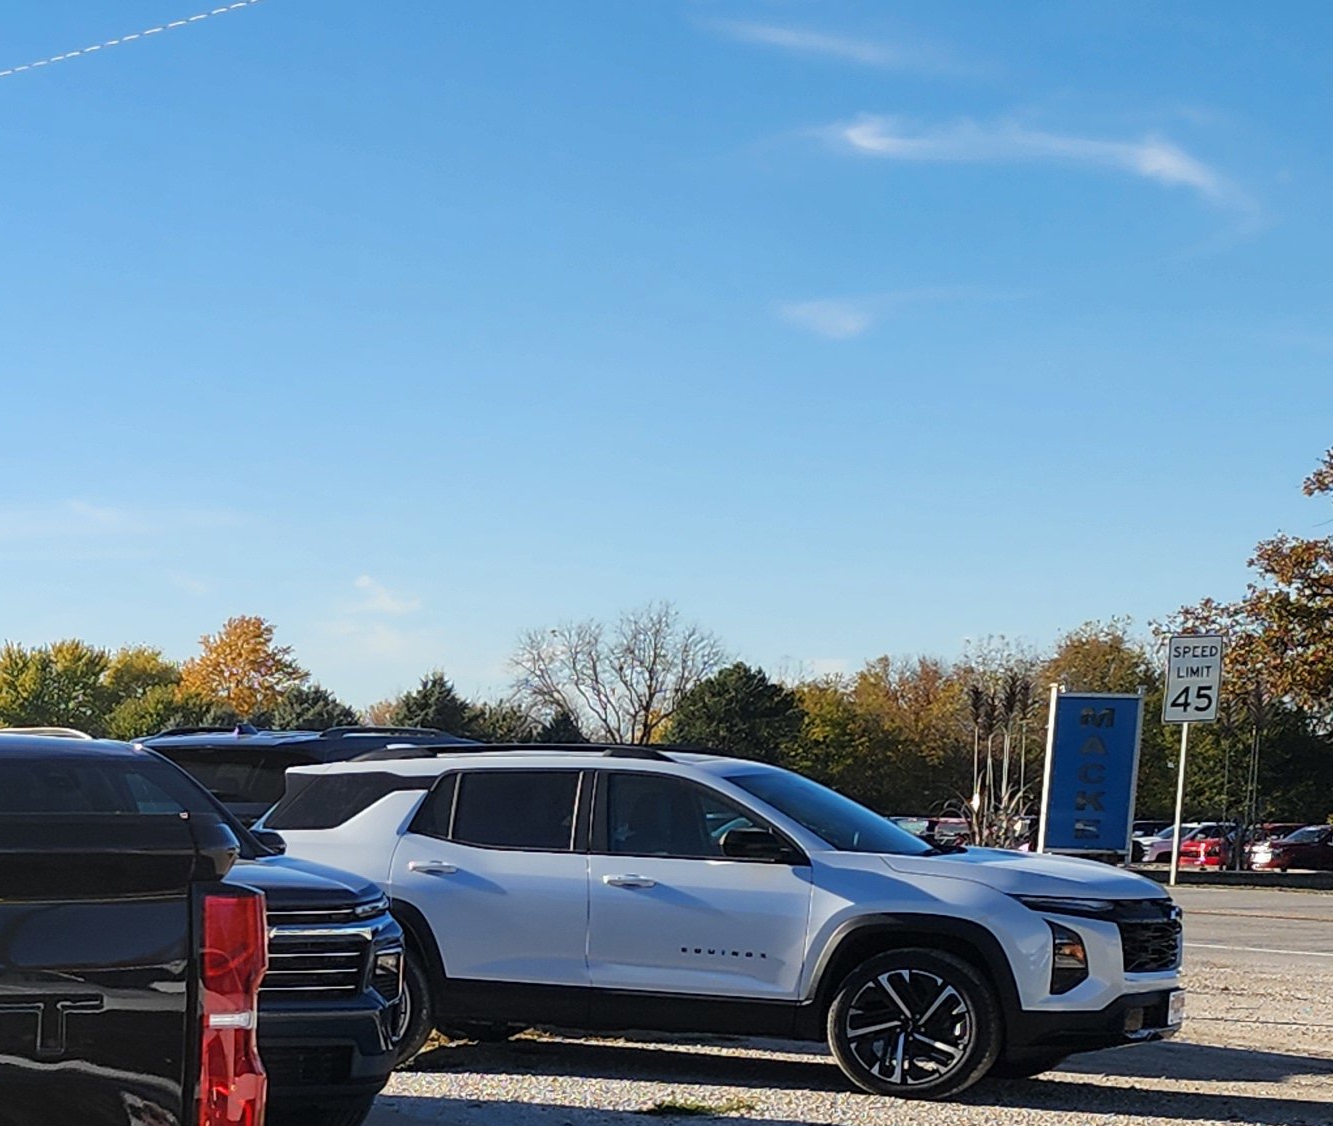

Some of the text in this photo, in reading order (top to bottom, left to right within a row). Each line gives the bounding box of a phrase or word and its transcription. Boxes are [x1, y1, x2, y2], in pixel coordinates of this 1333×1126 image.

[1173, 645, 1219, 658] SPEED
[1177, 665, 1212, 679] LIMIT
[1170, 685, 1213, 713] 45
[1074, 706, 1116, 840] MACKE
